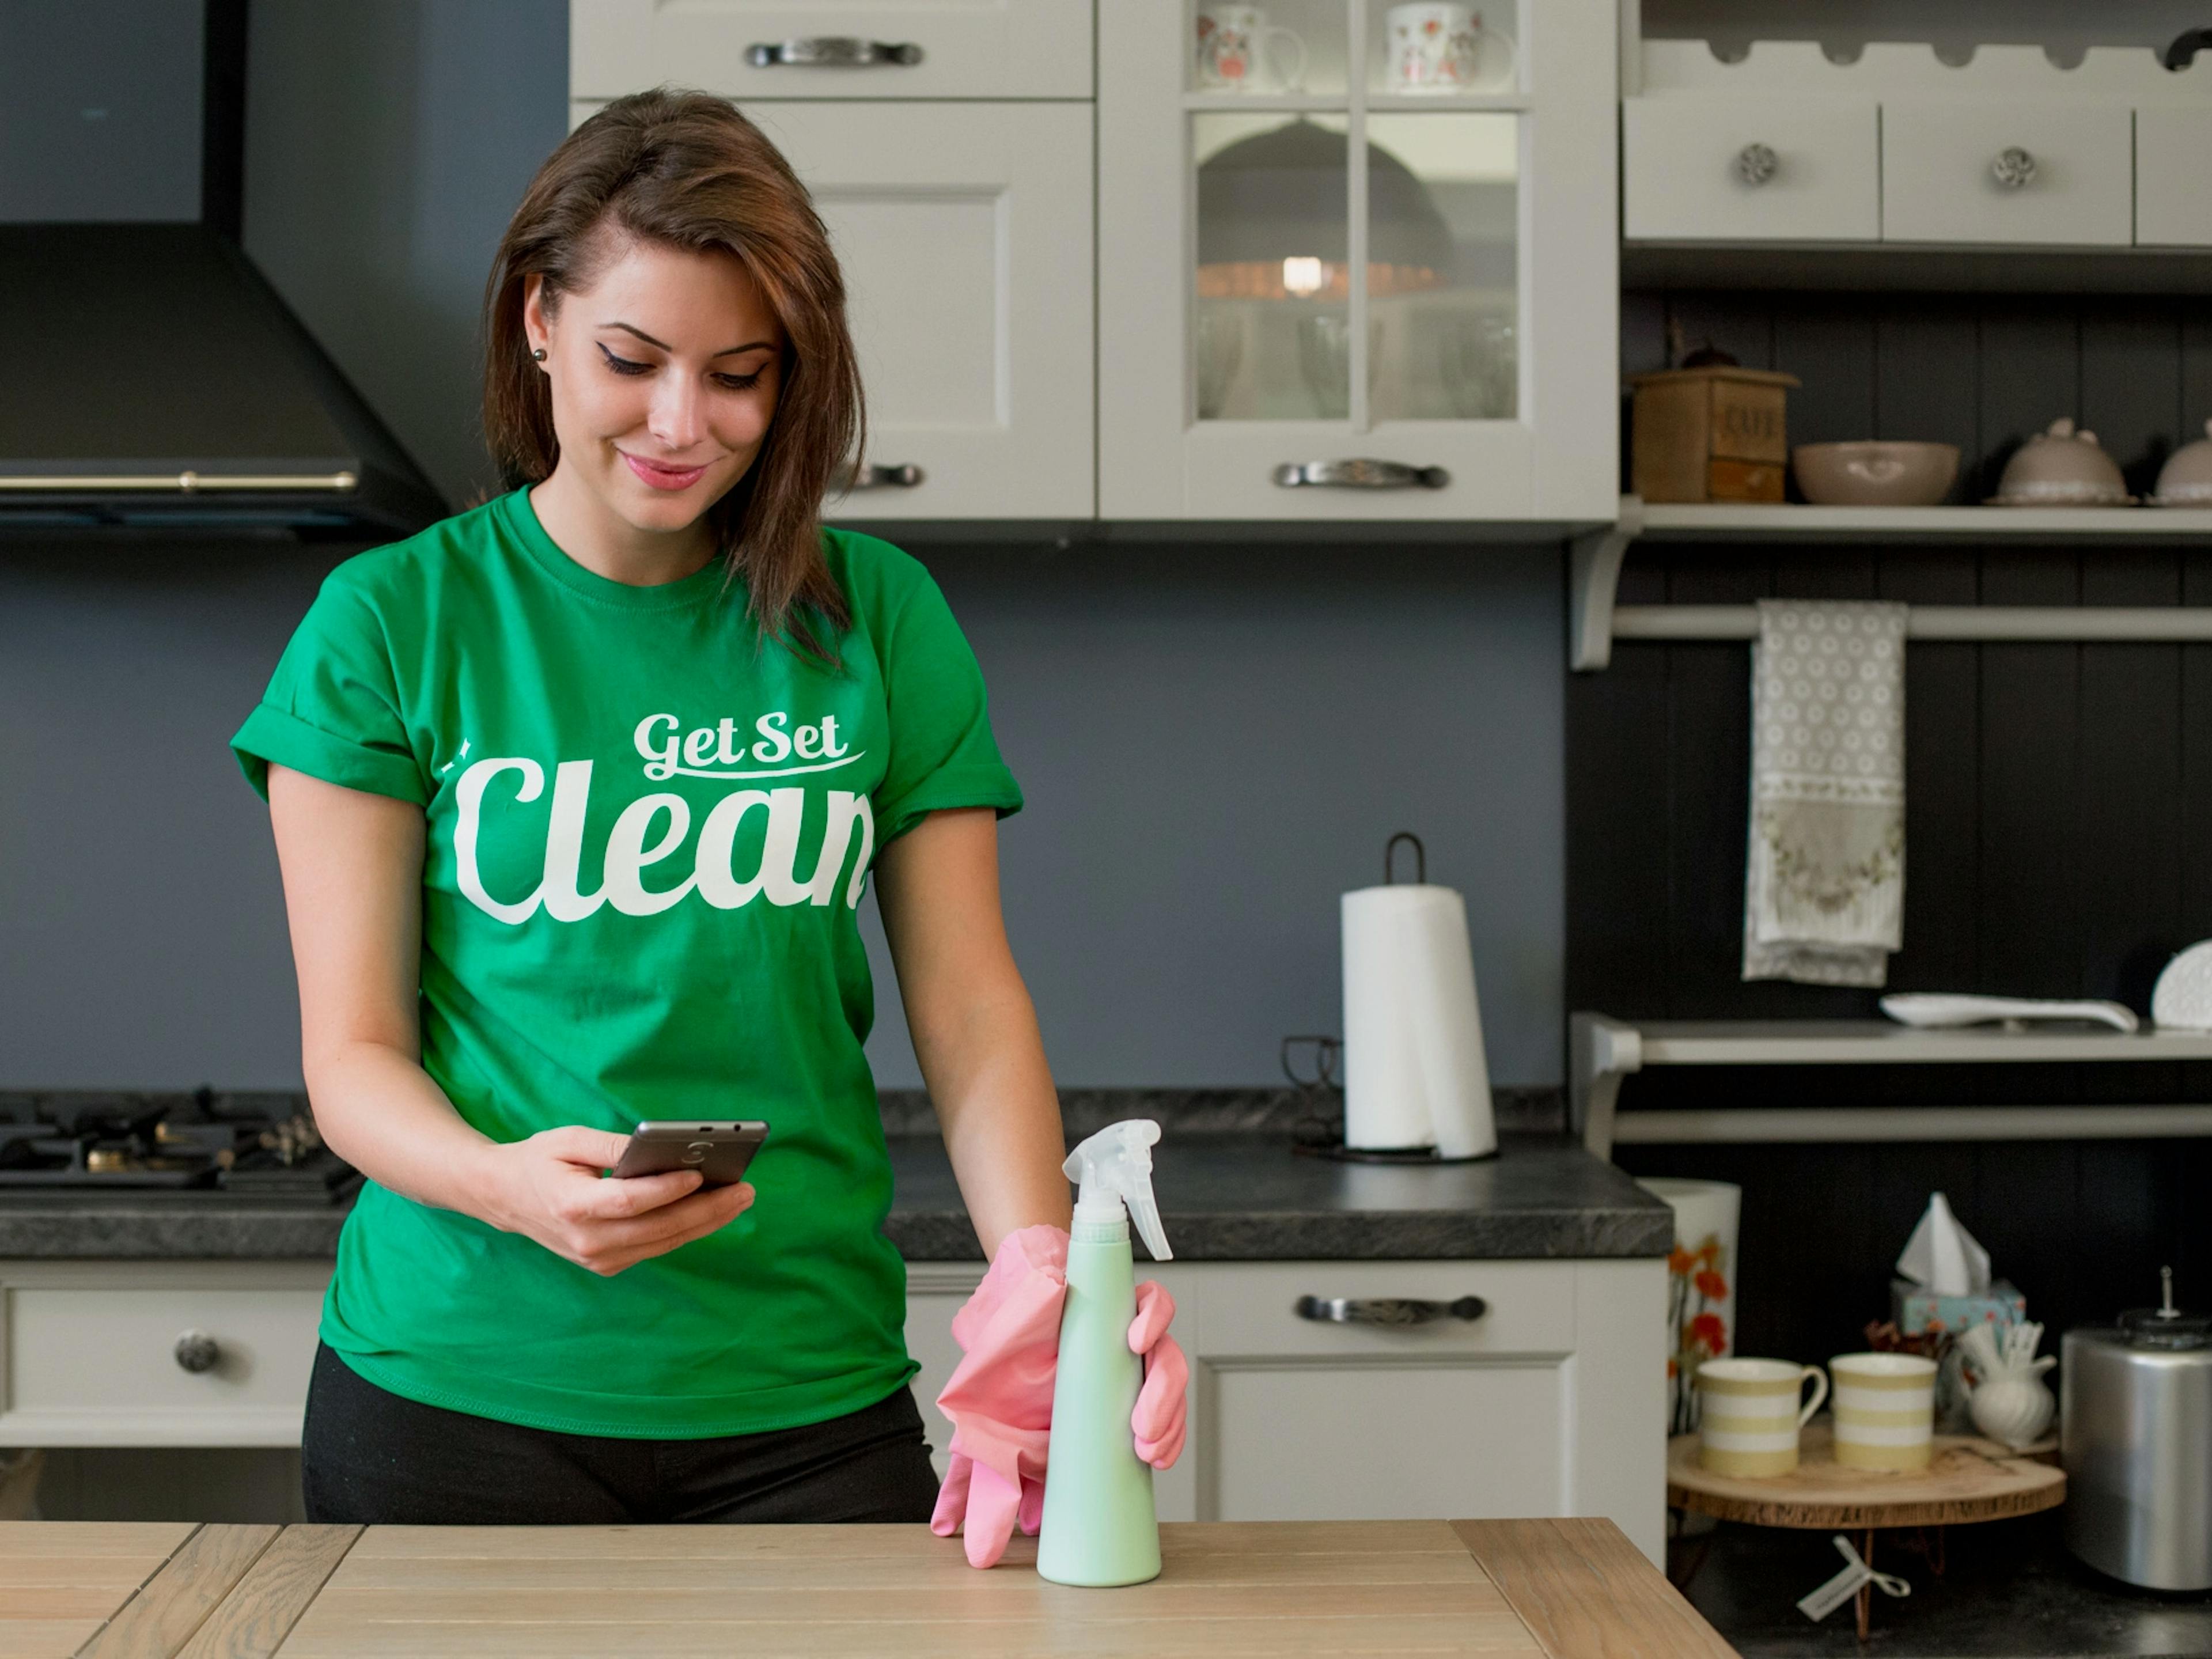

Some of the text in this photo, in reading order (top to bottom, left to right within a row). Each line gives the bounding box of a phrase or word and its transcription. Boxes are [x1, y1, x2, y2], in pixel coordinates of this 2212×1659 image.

[634, 712, 849, 781] Get Set
[454, 757, 874, 925] Clean
